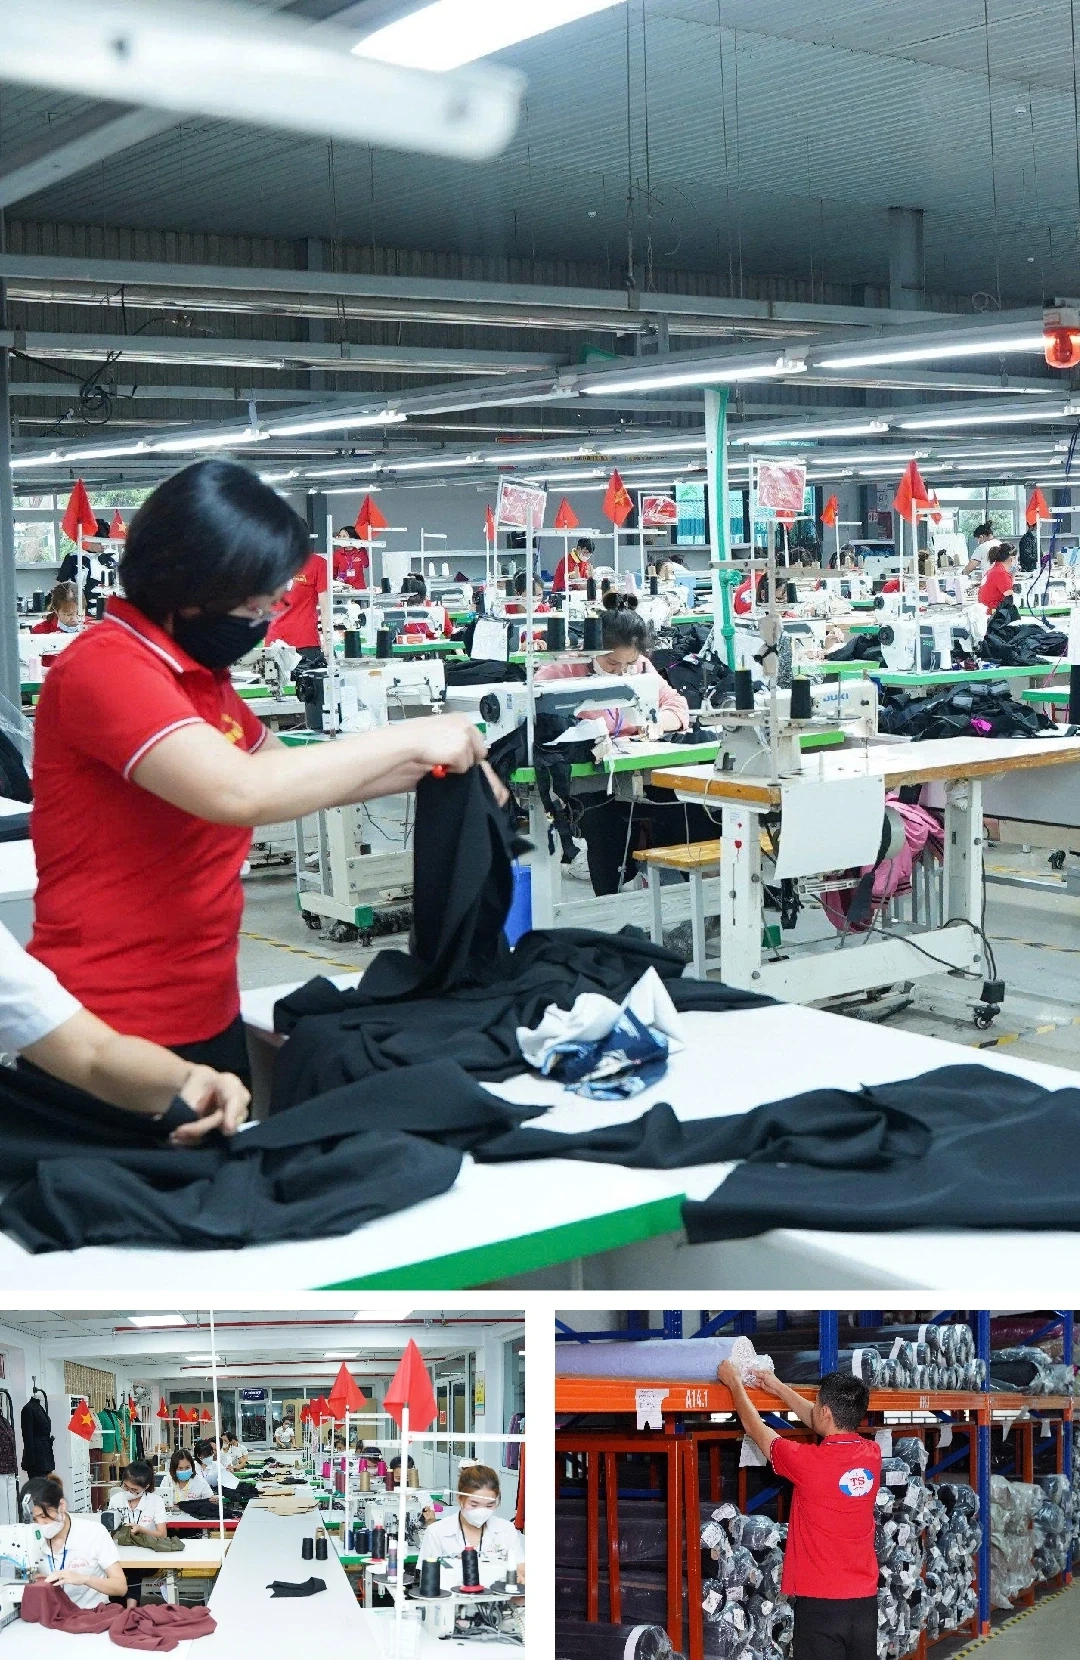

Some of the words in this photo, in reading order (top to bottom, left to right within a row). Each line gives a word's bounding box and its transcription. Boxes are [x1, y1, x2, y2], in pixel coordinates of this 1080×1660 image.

[823, 692, 849, 702] JUKI
[685, 1389, 708, 1409] A14.1
[850, 1476, 865, 1487] TS
